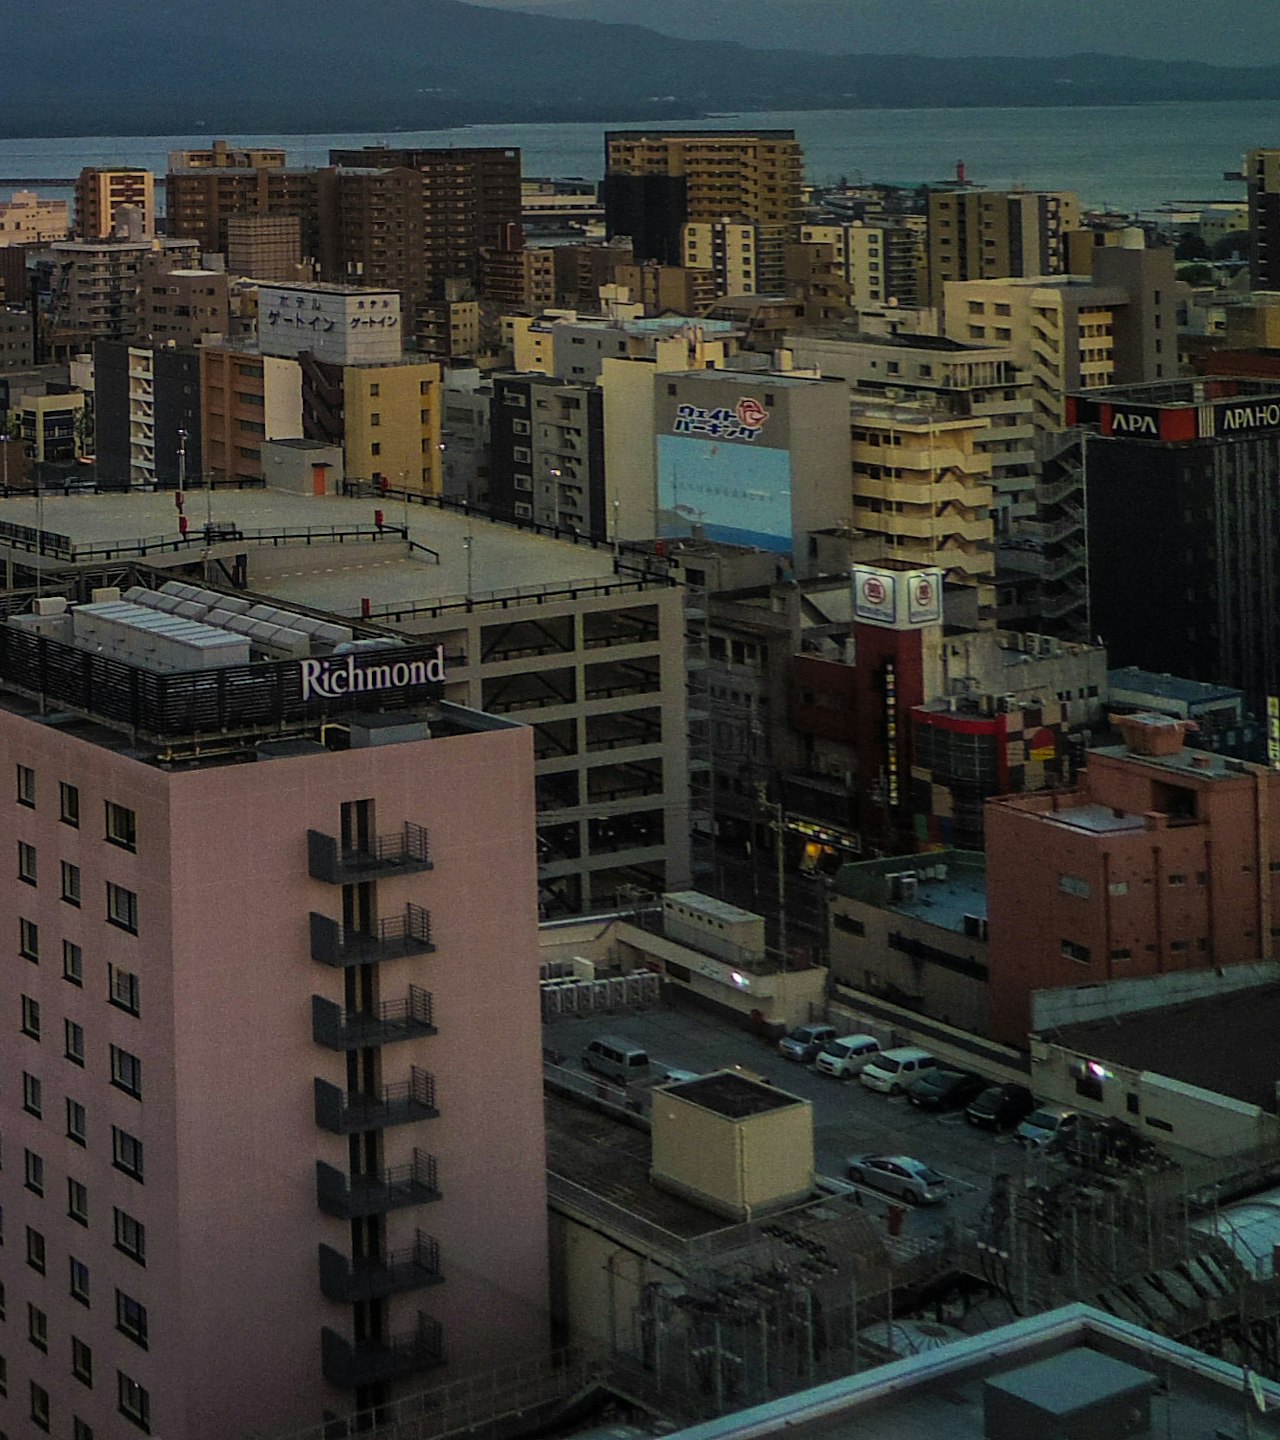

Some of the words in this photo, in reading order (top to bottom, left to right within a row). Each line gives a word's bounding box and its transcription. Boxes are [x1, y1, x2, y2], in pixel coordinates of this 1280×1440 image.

[268, 309, 334, 332] ゲートイン
[350, 316, 397, 329] ゲートイン
[679, 405, 738, 422] ウェイト
[1112, 413, 1158, 434] APA
[1223, 409, 1254, 430] APA
[1255, 403, 1280, 427] HO
[673, 418, 762, 440] パーキング
[299, 644, 446, 702] Richmond
